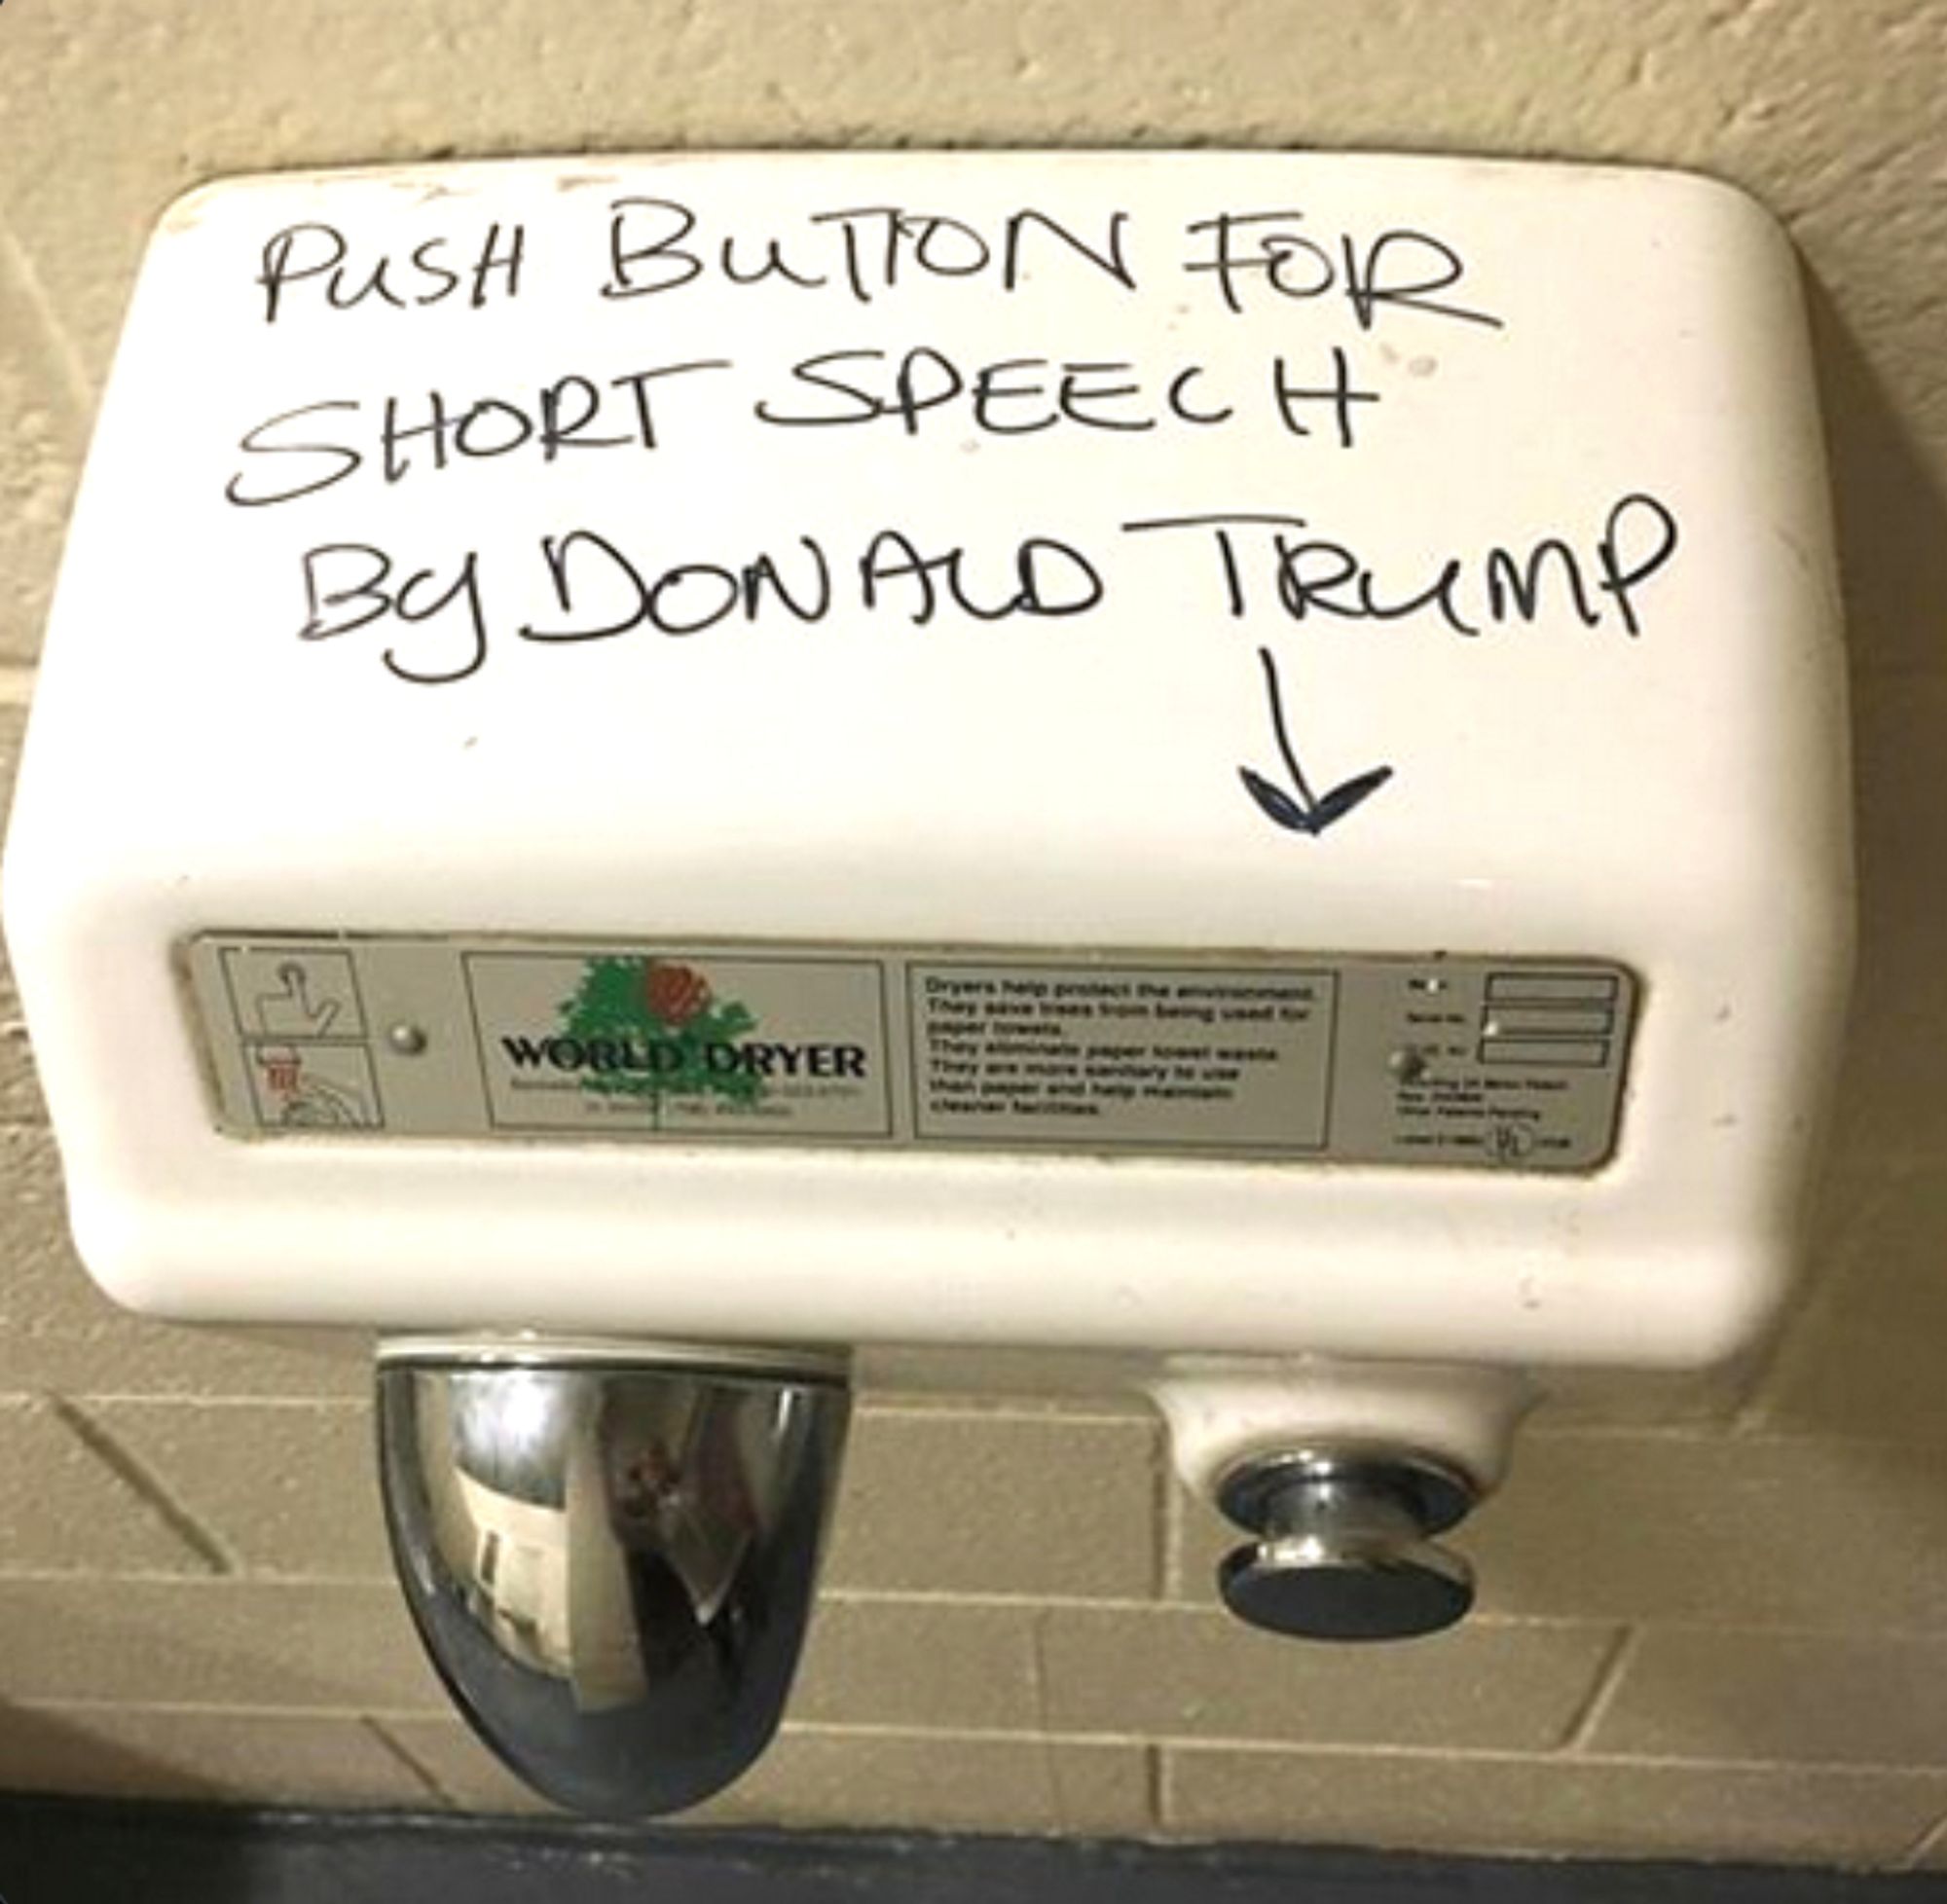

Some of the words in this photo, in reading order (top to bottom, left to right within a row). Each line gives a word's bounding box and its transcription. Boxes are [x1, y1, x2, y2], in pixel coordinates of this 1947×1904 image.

[1184, 209, 1504, 331] FOR
[225, 359, 730, 507] SHORT
[753, 346, 1380, 449] SPEECH
[518, 529, 1105, 644] DONALD
[1121, 493, 1679, 639] TRUMP
[501, 1035, 682, 1072] WORLD
[705, 1041, 866, 1079] DRYER
